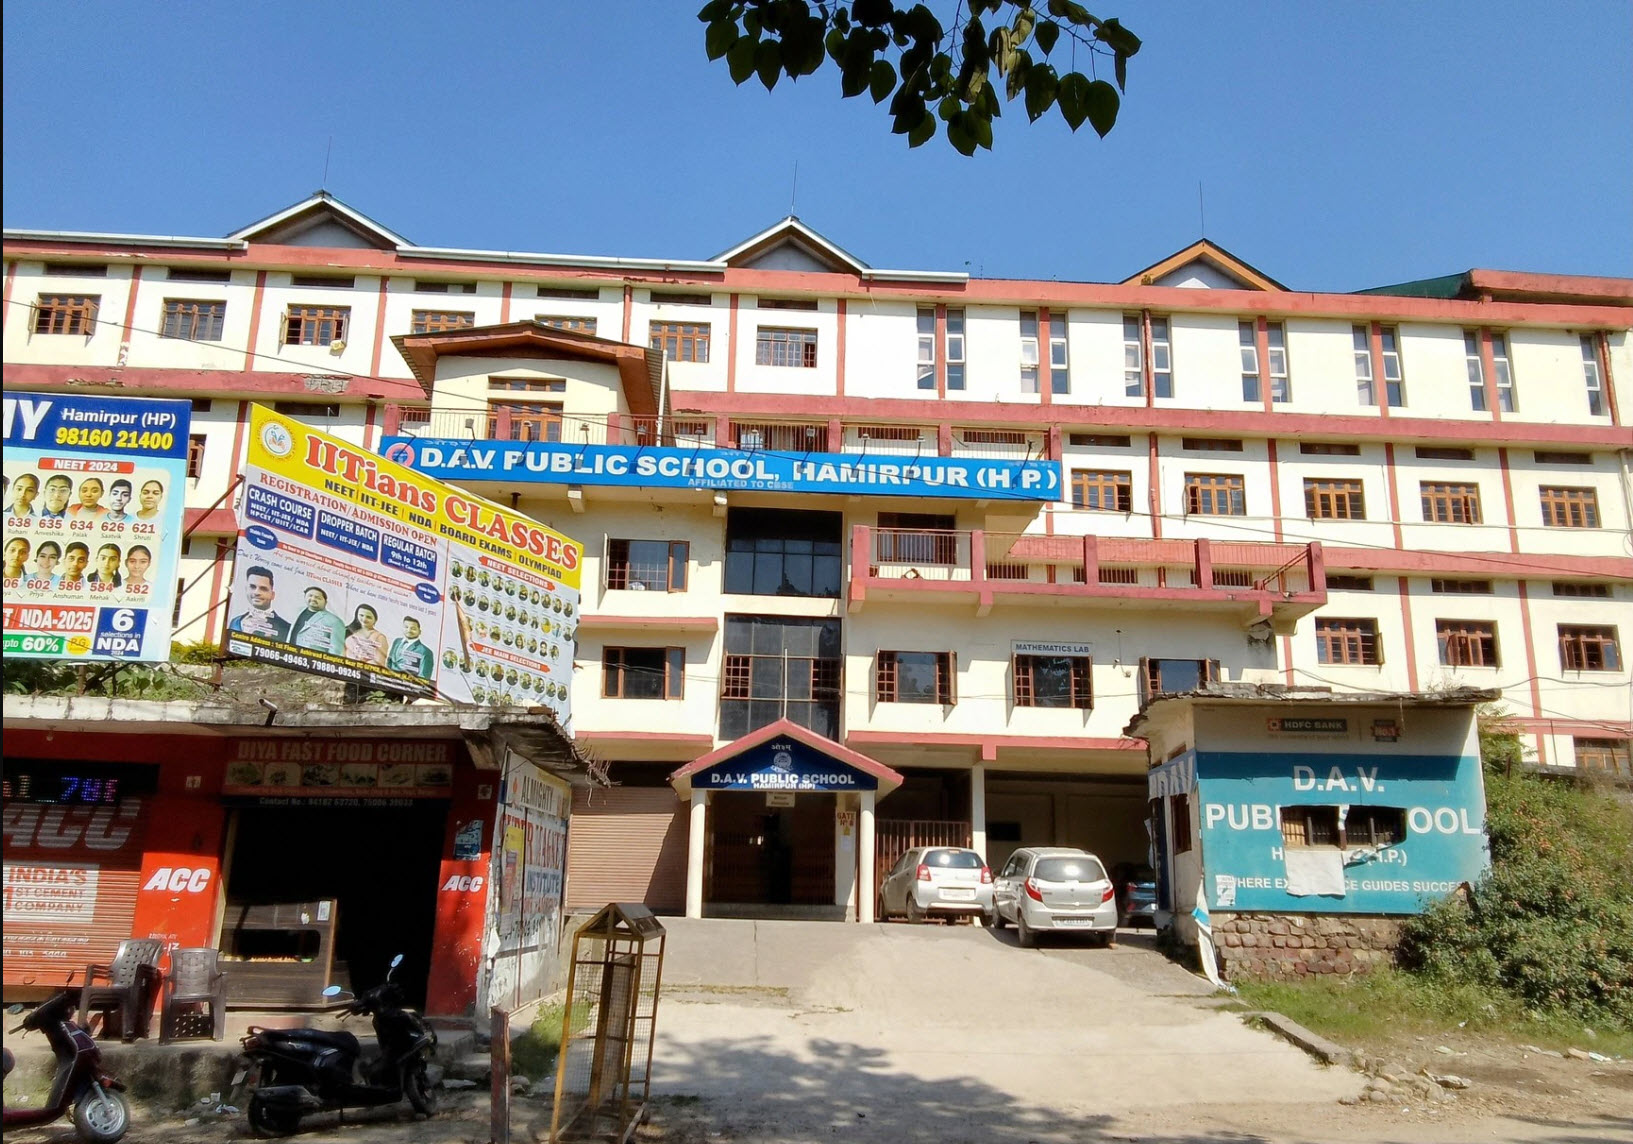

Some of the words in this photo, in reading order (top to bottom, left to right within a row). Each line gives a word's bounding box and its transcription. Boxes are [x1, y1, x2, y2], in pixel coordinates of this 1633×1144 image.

[62, 408, 137, 426] Hamirpur
[142, 412, 176, 429] (HP)
[55, 426, 112, 447] 98160
[115, 430, 173, 450] 21400
[54, 459, 86, 471] NEET
[88, 462, 118, 472] 2024
[420, 448, 494, 470] D.A.V.
[503, 451, 628, 475] PUBLIC
[636, 456, 780, 482] SCHOOL,
[793, 461, 968, 487] HAMIRPUR
[976, 467, 1057, 490] (HP.)
[688, 478, 748, 488] AFFILIATED
[751, 480, 765, 488] TO
[249, 488, 277, 507] CRASH
[280, 499, 312, 519] COURSE
[305, 435, 436, 513] IITians
[445, 496, 578, 570] CLASSES
[8, 517, 31, 528] 638
[39, 519, 62, 529] 635
[70, 520, 94, 531] 634
[101, 522, 125, 532] 626
[132, 523, 156, 534] 621
[321, 512, 354, 533] DROPPER
[355, 524, 377, 541] BATCH
[325, 479, 355, 498] NEET
[361, 493, 398, 515] IIT-JEE
[409, 512, 432, 529] NDA
[440, 524, 476, 545] BOARD
[479, 540, 512, 559] EXAMS
[519, 555, 562, 579] OLYMPIAD
[411, 530, 437, 546] OPEN
[384, 535, 414, 555] REGULAR
[415, 547, 435, 562] BATCH
[404, 555, 411, 563] to
[412, 559, 427, 570] 12th
[507, 564, 549, 588] SELECTIONS
[26, 579, 51, 590] 602
[58, 581, 82, 592] 586
[89, 583, 114, 593] 584
[126, 584, 149, 595] 582
[20, 608, 93, 630] NDA-2025
[112, 609, 135, 631] 6
[22, 637, 59, 652] 60%
[97, 638, 139, 651] NDA
[1015, 644, 1071, 652] MATHEMATICS
[1284, 720, 1311, 729] HDFC
[1315, 721, 1342, 729] BANK
[238, 741, 277, 760] DIYA
[281, 741, 323, 761] FAST
[327, 742, 373, 761] FOOD
[378, 743, 447, 762] CORNER
[711, 773, 747, 784] D.A.V.
[751, 773, 799, 784] PUBLIC
[802, 773, 855, 784] SCHOOL
[1293, 765, 1384, 792] D.A.V.
[9, 866, 87, 886] INDIA'S
[143, 868, 211, 893] ACC
[442, 875, 483, 893] ACC
[1237, 877, 1272, 888] HERE
[1362, 881, 1410, 892] GUIDES
[34, 888, 85, 898] CEMENT
[15, 901, 83, 912] COMPANY
